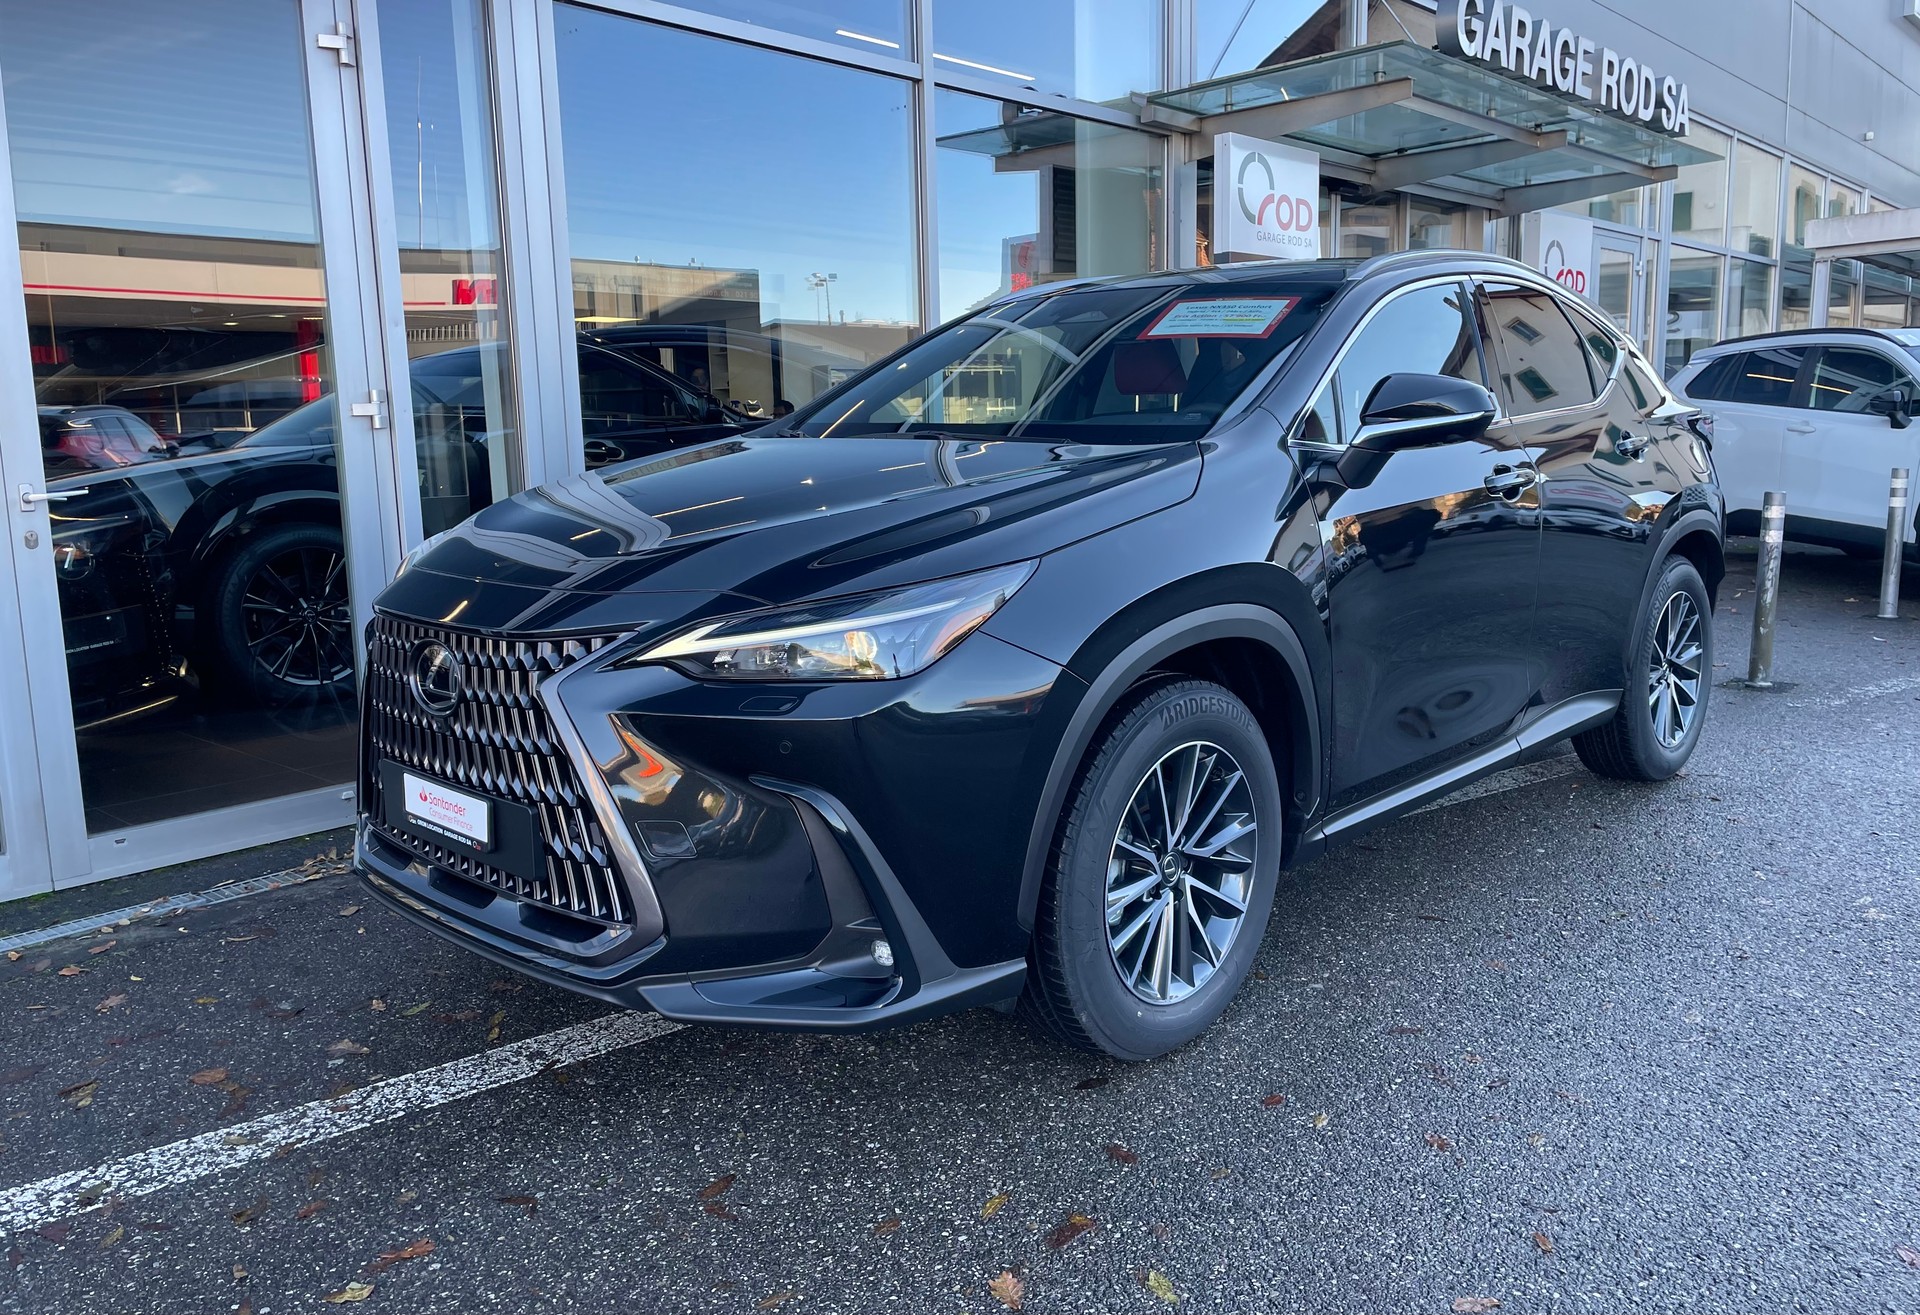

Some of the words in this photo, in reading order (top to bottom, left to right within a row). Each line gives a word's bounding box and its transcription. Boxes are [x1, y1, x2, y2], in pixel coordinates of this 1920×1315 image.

[1457, 0, 1595, 100] GARAGE
[1600, 47, 1656, 122] ROD
[1661, 75, 1690, 137] SA
[1256, 230, 1286, 245] GARAGE
[1287, 235, 1303, 248] ROD
[1304, 237, 1313, 248] SA
[1158, 696, 1253, 733] BRIDGESTONE
[428, 792, 466, 816] Santander
[429, 807, 454, 825] Consumer
[453, 816, 473, 832] Finance
